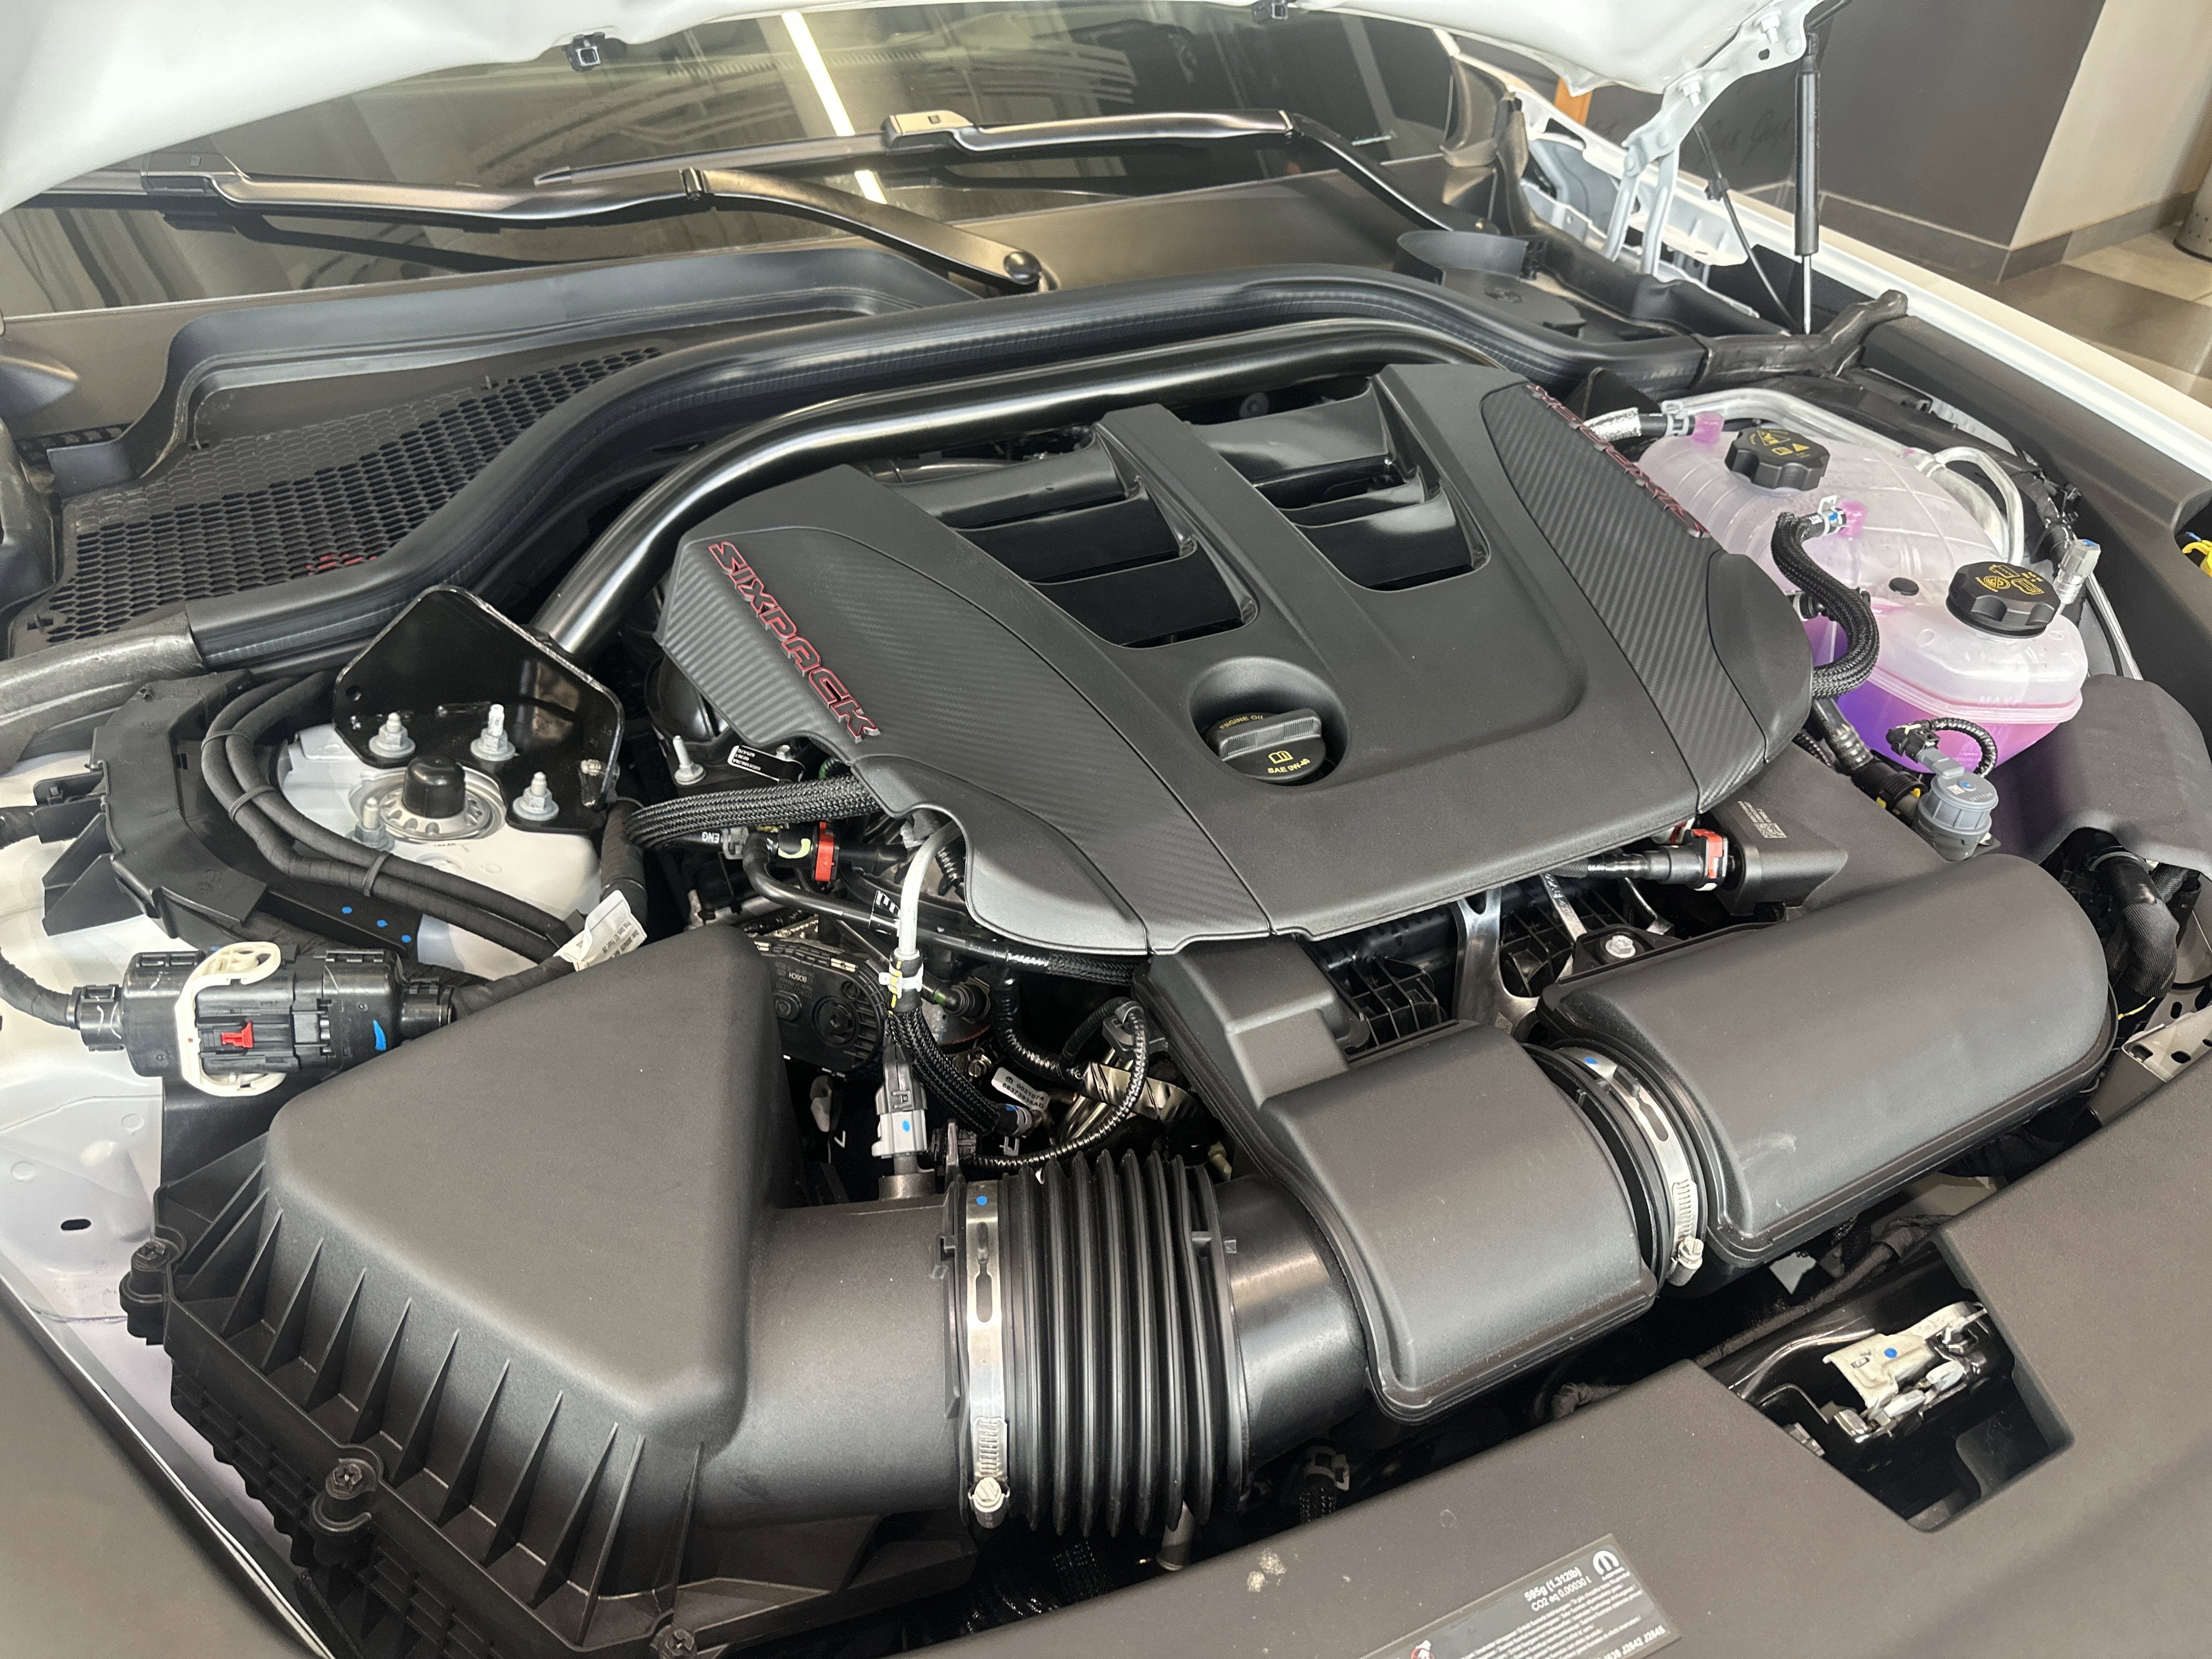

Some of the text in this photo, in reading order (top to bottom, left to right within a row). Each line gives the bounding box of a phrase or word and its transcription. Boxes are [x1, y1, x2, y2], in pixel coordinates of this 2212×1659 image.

[708, 541, 881, 743] SIXPACK
[1219, 715, 1249, 729] ENGINE
[1287, 758, 1311, 771] 0W-40
[701, 831, 720, 844] ENG
[788, 972, 808, 983] BOSCH
[1524, 1586, 1548, 1601] 595g
[1531, 1597, 1550, 1611] CO2
